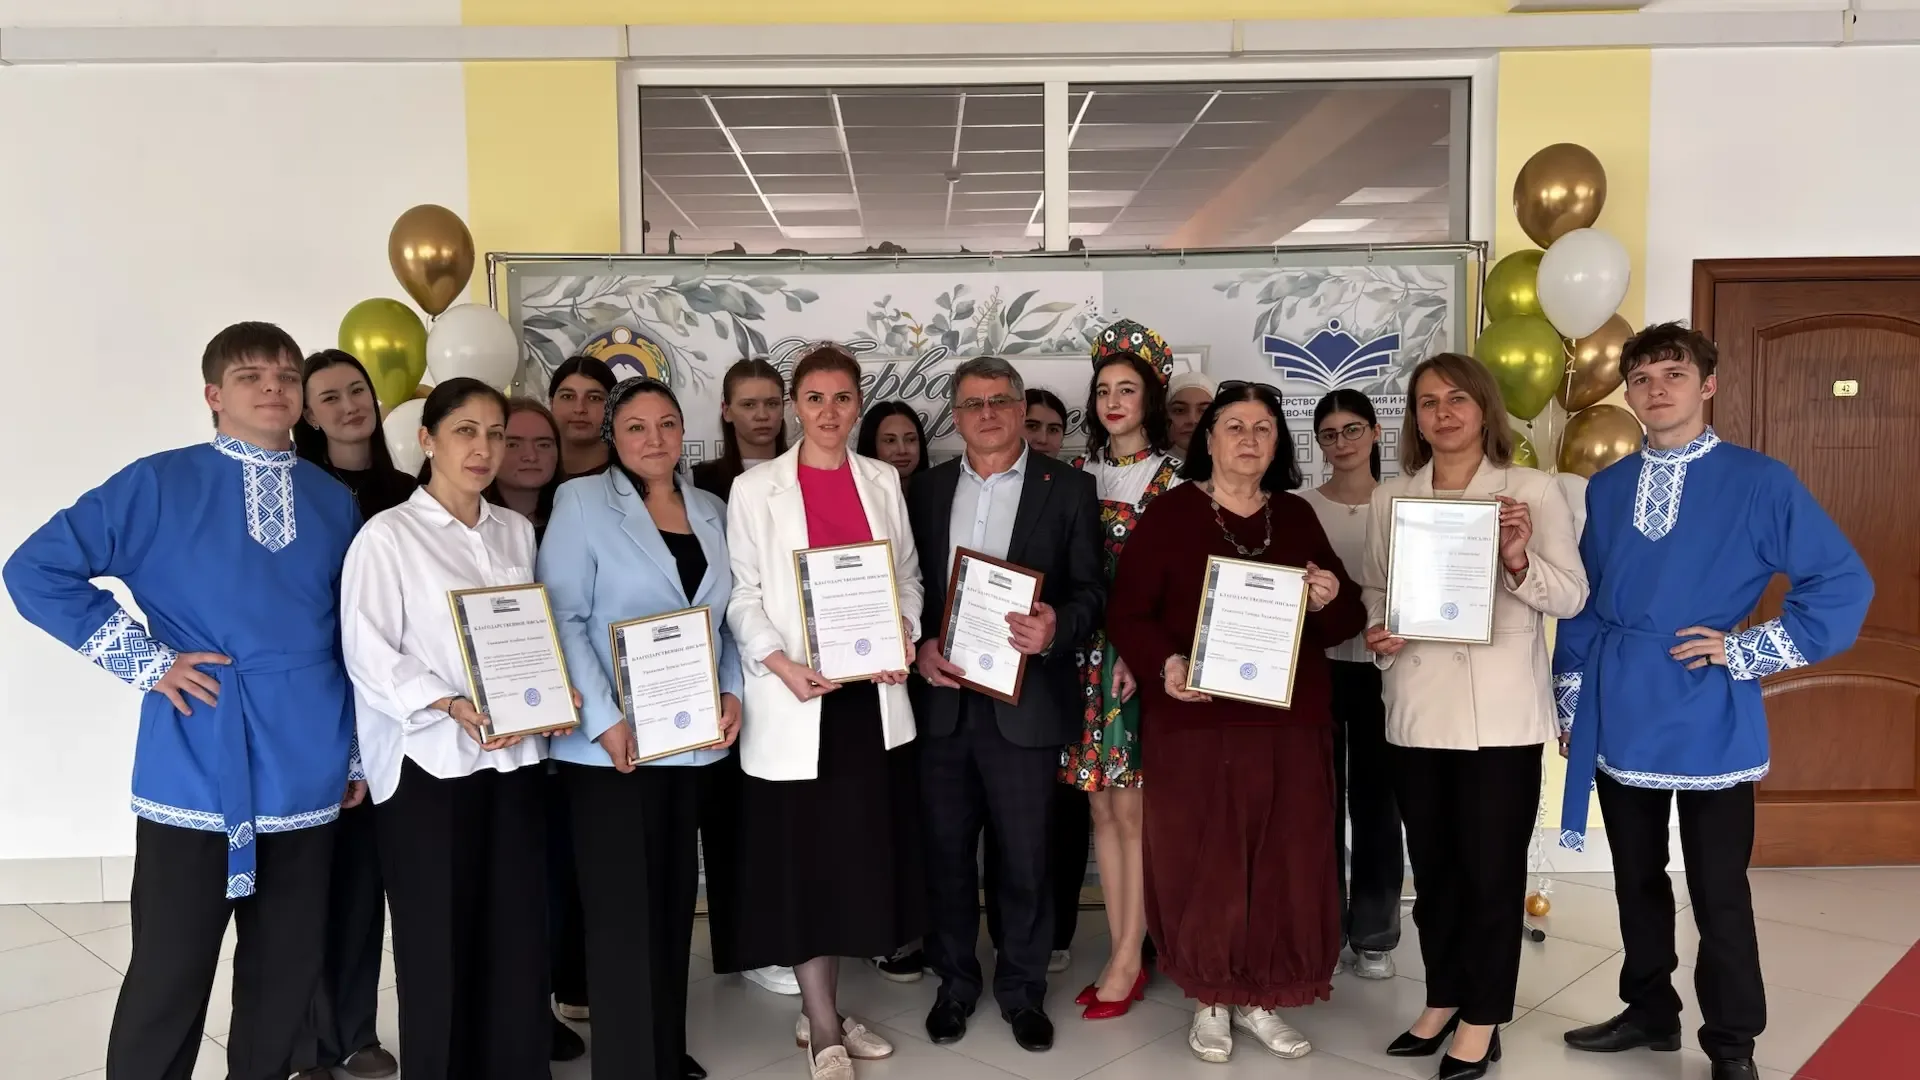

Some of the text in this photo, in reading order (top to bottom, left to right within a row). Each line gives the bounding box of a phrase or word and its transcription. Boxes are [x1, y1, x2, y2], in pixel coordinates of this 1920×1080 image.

[1842, 384, 1850, 392] 42
[1282, 398, 1316, 406] ЕРСТВО
[1390, 396, 1397, 404] И
